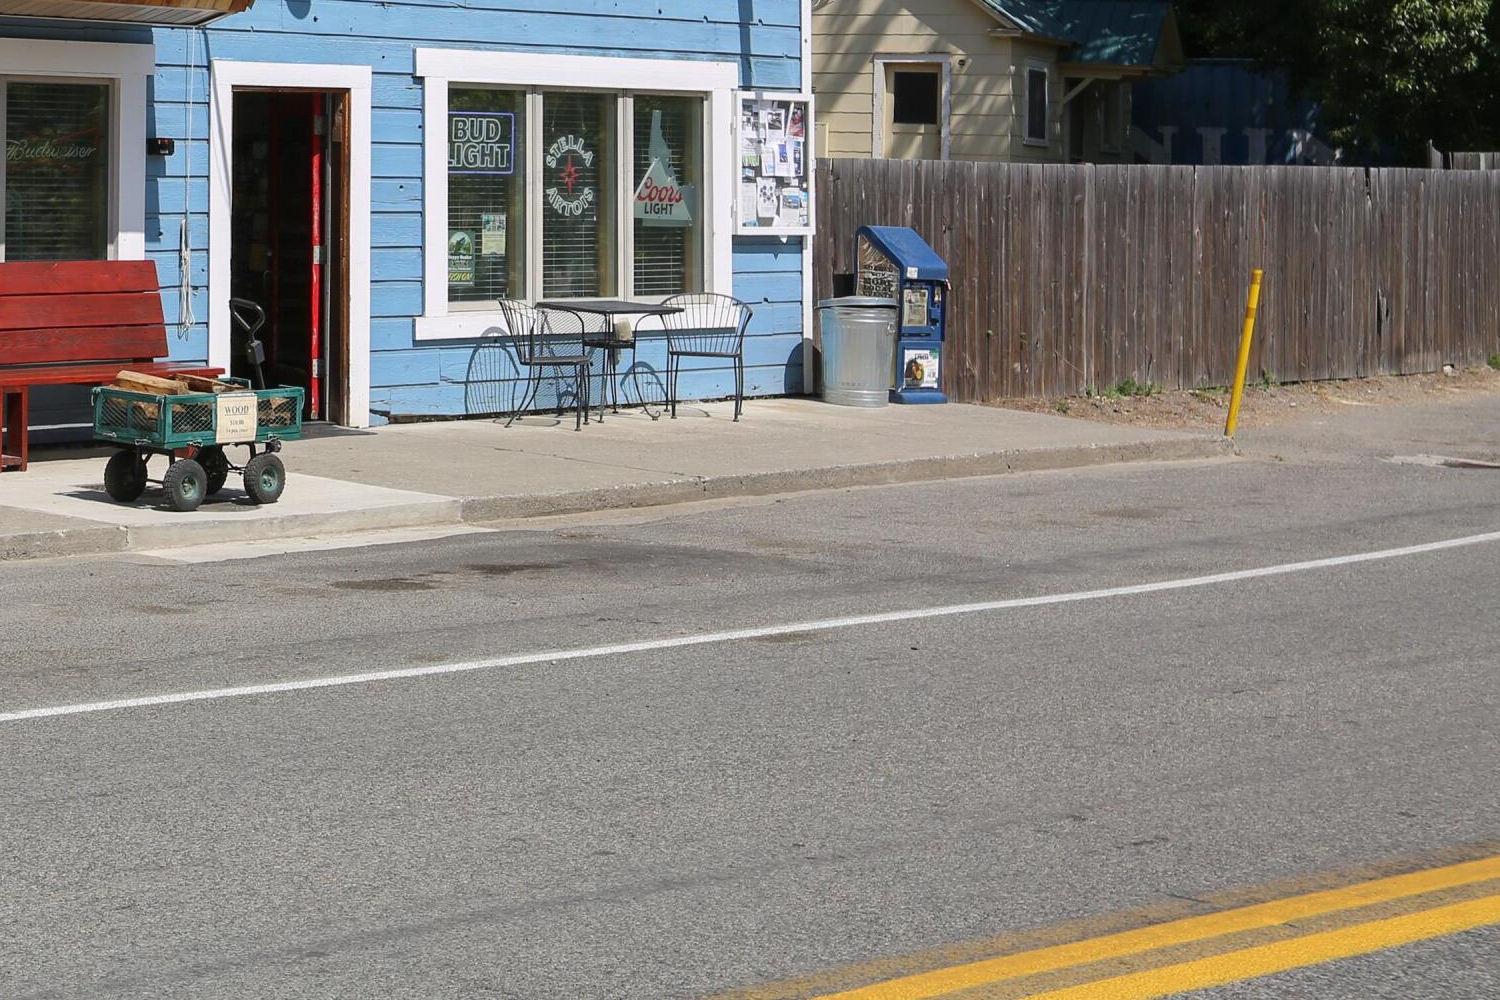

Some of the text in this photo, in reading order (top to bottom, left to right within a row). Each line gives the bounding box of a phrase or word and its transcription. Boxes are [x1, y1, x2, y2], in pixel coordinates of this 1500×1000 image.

[452, 117, 501, 143] BUD
[448, 142, 510, 168] LIGHT
[546, 134, 594, 169] STELLA
[546, 187, 594, 217] ARTOIS
[637, 176, 684, 203] Coors
[644, 202, 674, 215] LIGHT
[224, 405, 249, 414] WOOD
